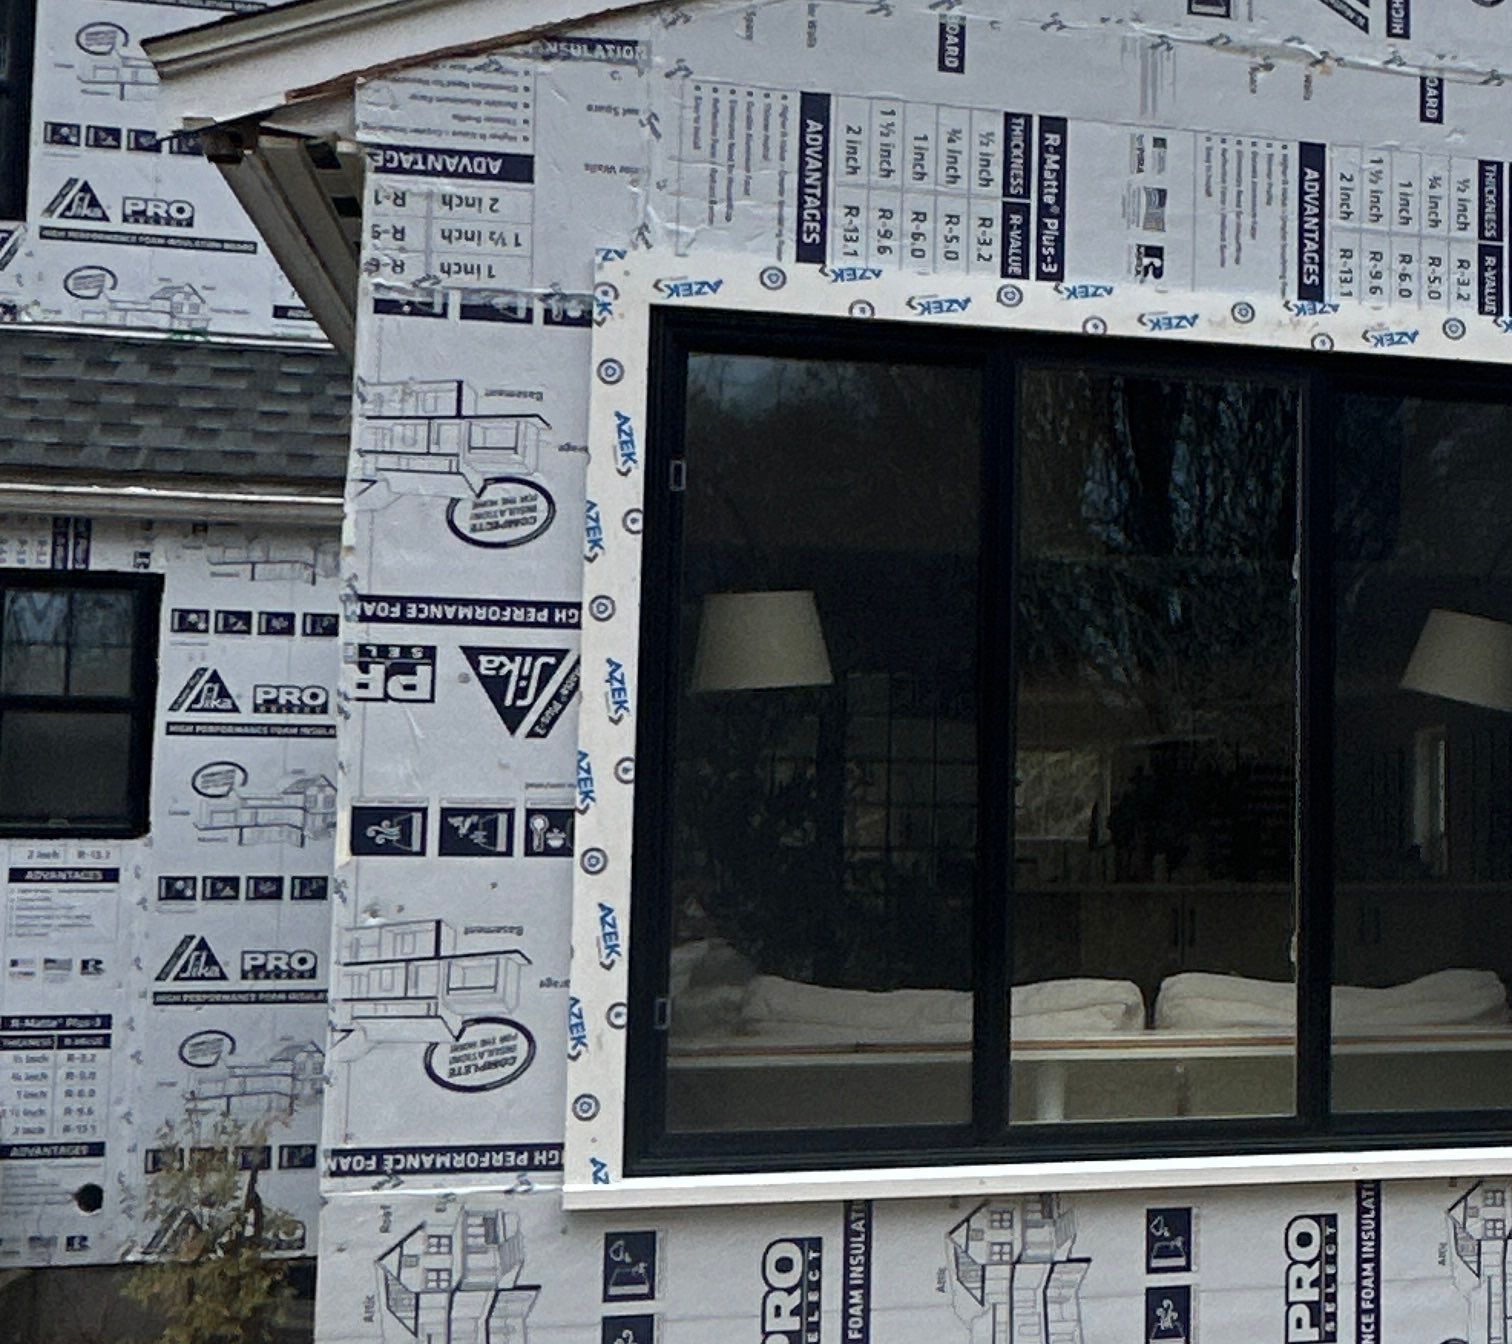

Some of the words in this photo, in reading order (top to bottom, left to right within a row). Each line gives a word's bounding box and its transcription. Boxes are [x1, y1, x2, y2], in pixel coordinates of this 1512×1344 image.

[1392, 8, 1406, 34] HIGH
[846, 124, 862, 137] 2
[845, 138, 861, 176] inch
[878, 141, 894, 179] inch
[911, 145, 928, 183] inch
[944, 148, 961, 186] inch
[977, 150, 994, 188] inch
[1008, 116, 1025, 196] THICKNESS
[801, 119, 825, 245] ADVANTAGES
[125, 199, 194, 218] PRO
[441, 194, 483, 211] inch
[1338, 186, 1355, 222] inch
[1368, 188, 1382, 223] inch
[1397, 190, 1411, 226] inch
[1426, 192, 1440, 229] inch
[1454, 196, 1470, 233] inch
[440, 228, 483, 246] inch
[842, 205, 860, 258] R-13.1
[876, 209, 893, 256] R-9.6
[910, 211, 926, 260] R-6.0
[943, 214, 960, 262] R-5.0
[976, 217, 993, 263] R-3.2
[1007, 214, 1024, 276] R-VALUE
[1041, 217, 1060, 274] Plus-3
[1302, 167, 1321, 288] ADVANTAGES
[440, 261, 482, 278] inch
[666, 279, 723, 297] AZEK
[831, 267, 883, 283] AZEK
[1338, 248, 1354, 299] R-13.1
[1368, 251, 1384, 297] R-9.6
[1397, 252, 1412, 299] R-6.0
[1427, 256, 1442, 301] R-5.0
[1455, 258, 1471, 301] R-3.2
[919, 296, 972, 315] AZEK
[1066, 284, 1114, 299] AZEK
[1294, 301, 1340, 317] AZEK
[1148, 313, 1200, 330] AZEK
[1374, 330, 1420, 347] AZEK
[612, 411, 636, 470] AZEK
[584, 500, 604, 558] AZEK
[405, 602, 548, 623] PERFORMANCE
[255, 686, 326, 705] PRO
[478, 655, 556, 707] Sika
[606, 658, 630, 716] AZEK
[577, 750, 597, 806] AZEK
[599, 903, 622, 959] AZEK
[243, 951, 317, 969] PRO
[568, 996, 589, 1051] AZEK
[384, 1149, 531, 1170] PERFORMANCE
[1287, 1217, 1321, 1343] PRO
[1323, 1224, 1337, 1334] SELECT
[1360, 1264, 1376, 1309] FOAM
[848, 1295, 865, 1340] FOAM
